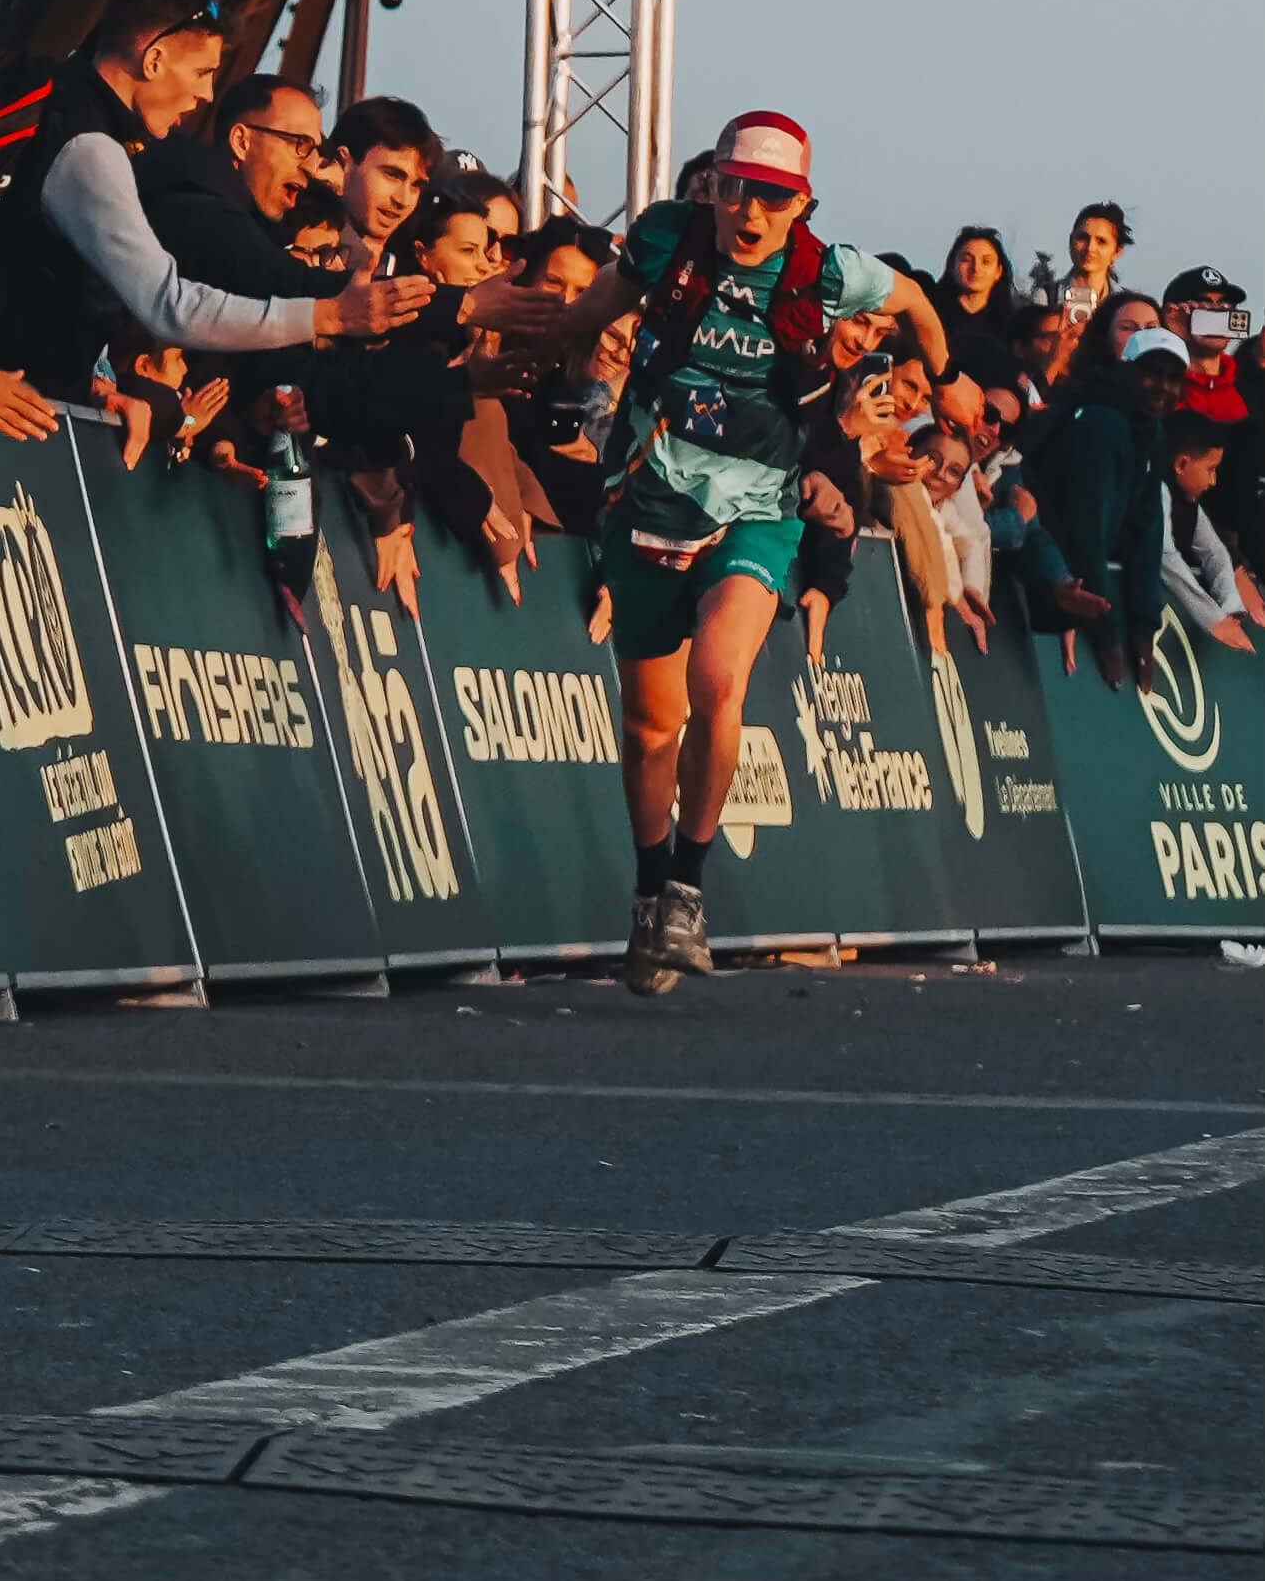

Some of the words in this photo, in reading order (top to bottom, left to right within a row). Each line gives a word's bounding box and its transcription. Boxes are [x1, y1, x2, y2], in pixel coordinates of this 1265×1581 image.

[133, 642, 314, 749] FINISHERS
[452, 665, 620, 764] SALOMON
[1159, 782, 1215, 812] VILLE
[1221, 783, 1248, 812] DE
